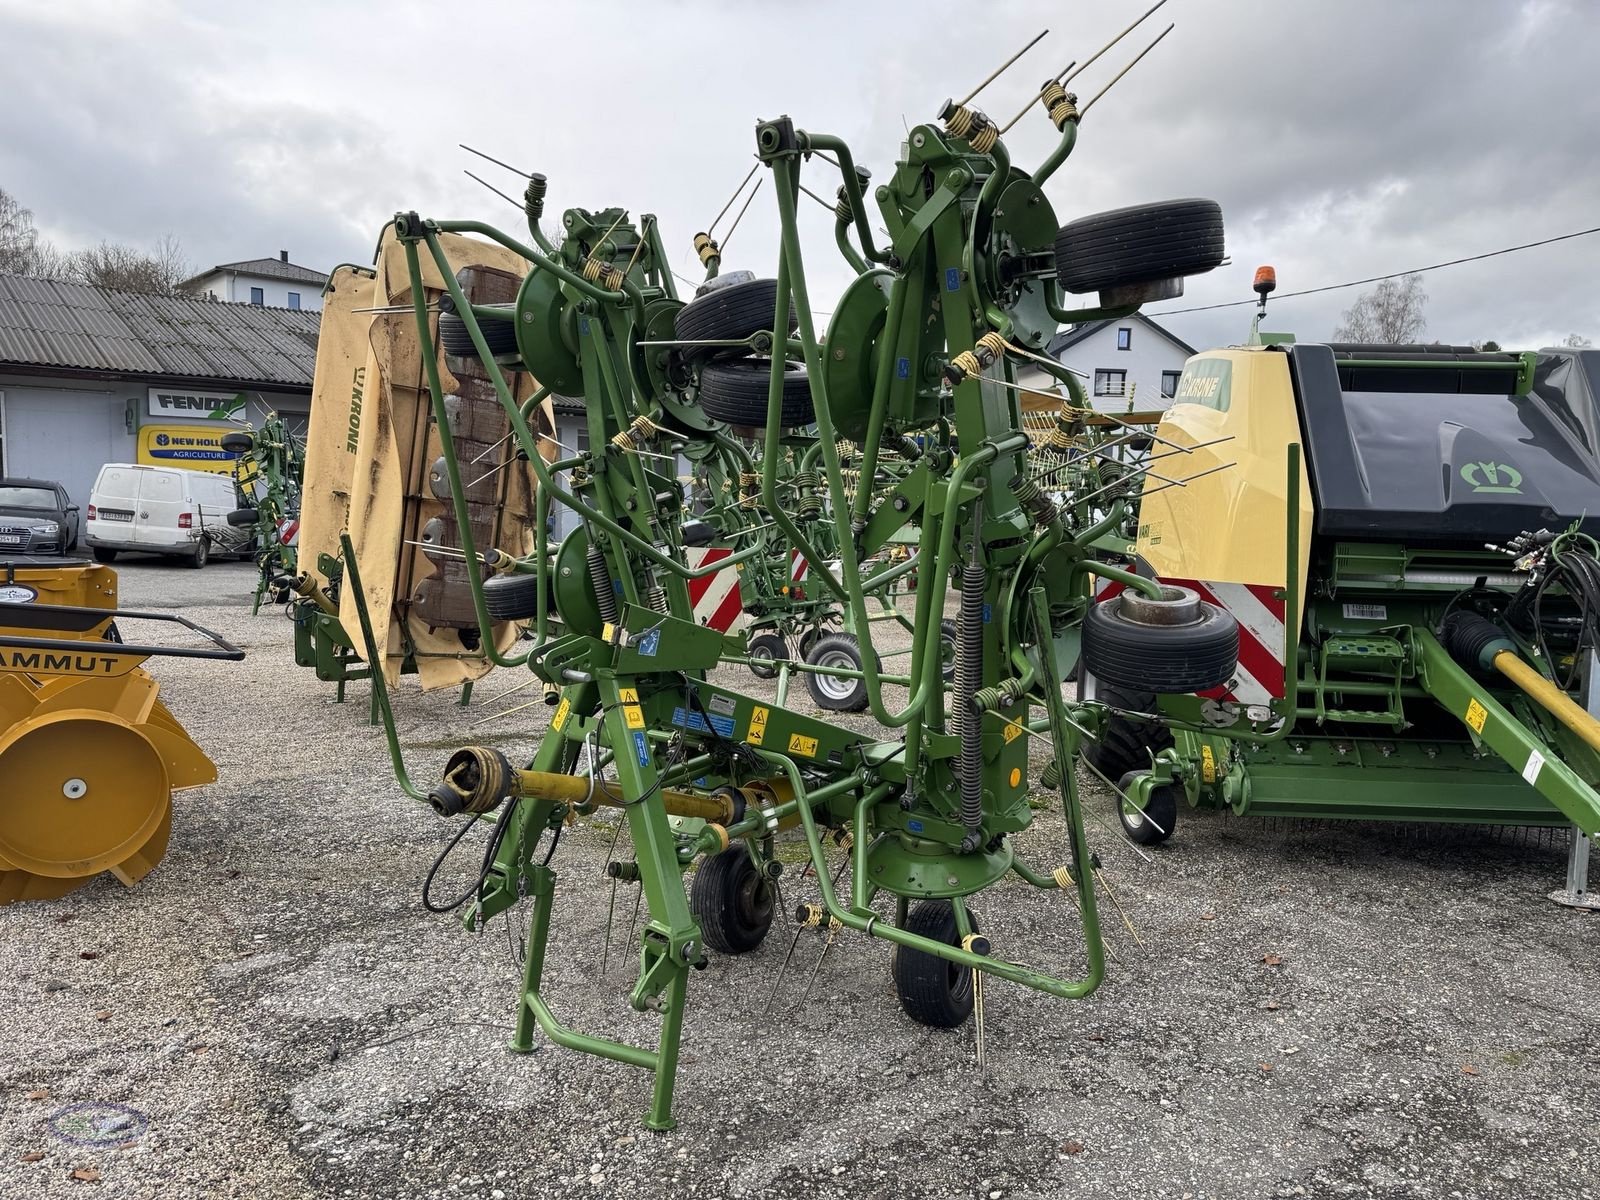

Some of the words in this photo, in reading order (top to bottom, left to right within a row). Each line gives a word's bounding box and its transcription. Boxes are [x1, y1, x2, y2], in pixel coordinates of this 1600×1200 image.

[1186, 377, 1220, 398] KRONE
[157, 394, 233, 411] FENDT
[346, 386, 363, 455] KRONE
[172, 437, 195, 446] NEW
[196, 438, 222, 447] HOLL
[0, 651, 119, 673] MMUT
